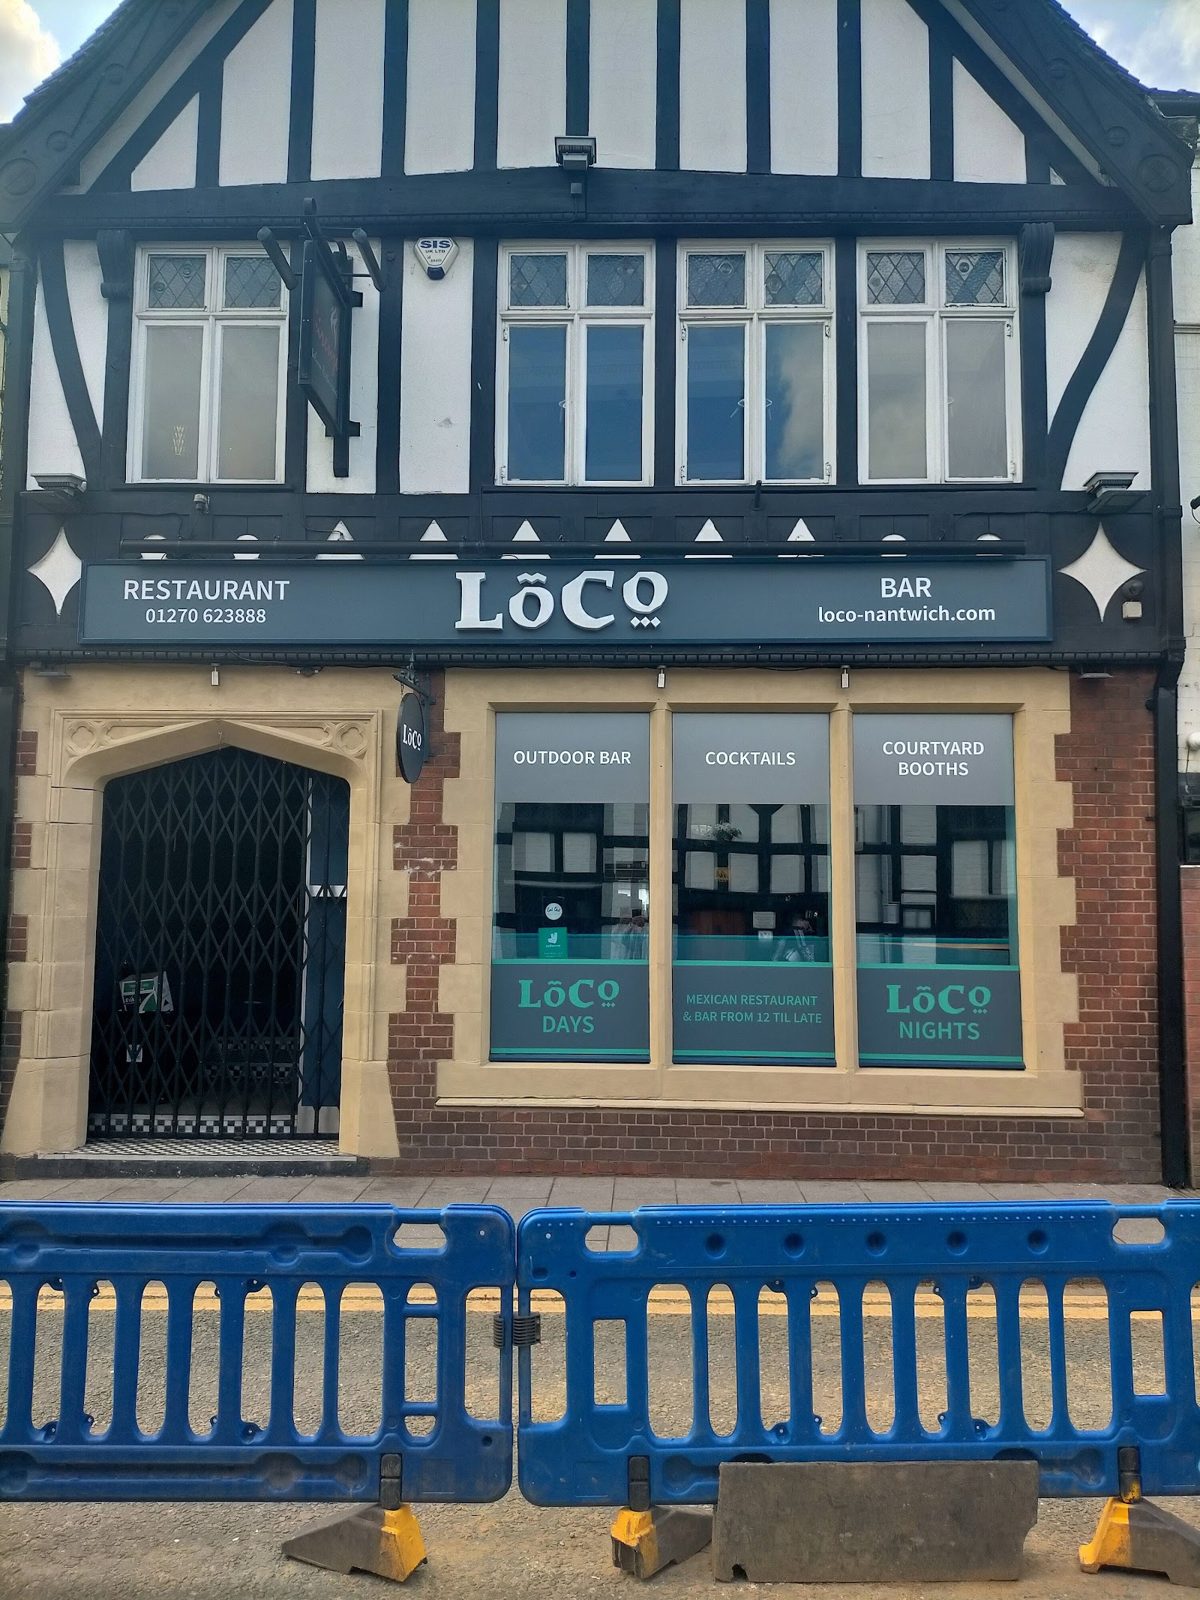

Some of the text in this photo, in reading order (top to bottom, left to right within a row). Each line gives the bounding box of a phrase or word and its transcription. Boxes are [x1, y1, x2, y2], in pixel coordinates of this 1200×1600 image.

[420, 240, 450, 249] SIS
[124, 580, 289, 600] RESTAURANT
[882, 578, 931, 597] BAR
[146, 609, 265, 623] 01270 623888
[819, 606, 995, 622] loco-nantwich.com
[883, 742, 984, 754] COURTYARD
[514, 751, 630, 764] OUTDOOR BAR
[706, 752, 795, 765] COCKTAILS
[899, 762, 968, 775] BOOTHS
[685, 994, 818, 1007] MEXICAN RESTAURANT
[682, 1012, 822, 1024] & BAR FROM 12 TIL LATE
[542, 1016, 595, 1034] DAYS
[898, 1022, 980, 1041] NIGHTS
